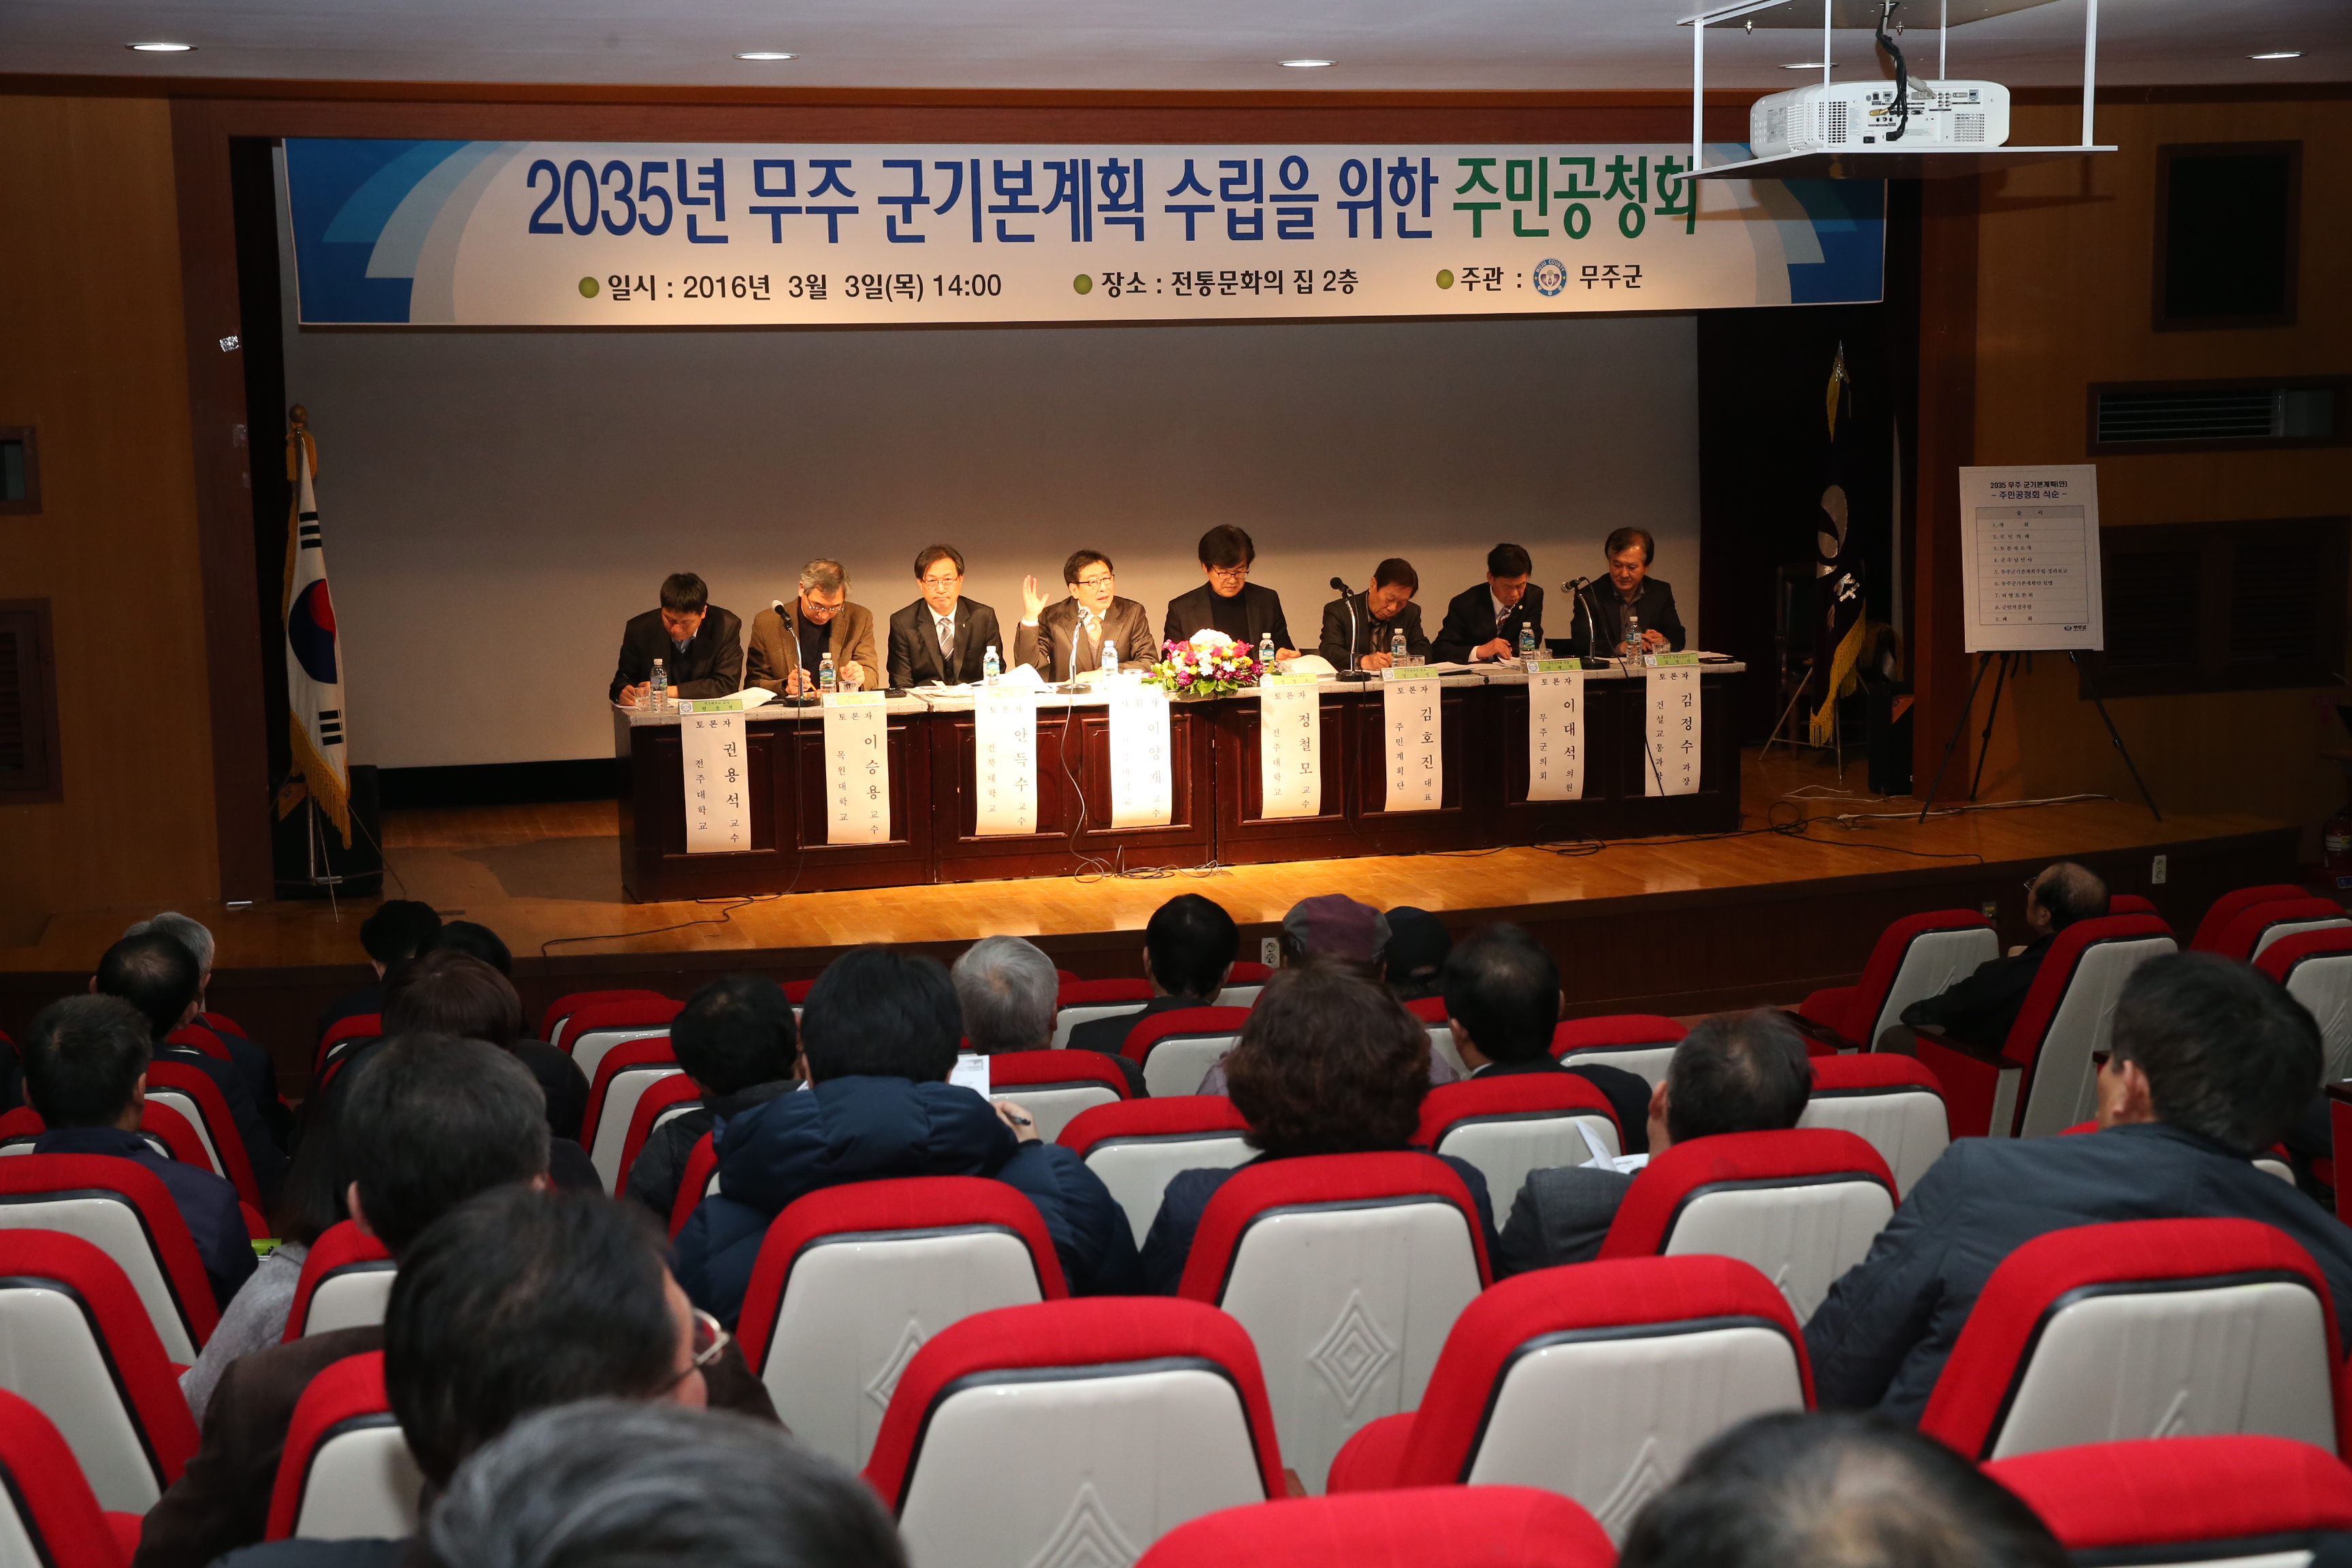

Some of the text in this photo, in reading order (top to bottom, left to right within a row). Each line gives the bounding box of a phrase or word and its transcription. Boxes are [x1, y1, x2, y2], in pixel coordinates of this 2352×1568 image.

[527, 155, 1697, 244] 2035년 무주 군기본계획 수립을 위한 주민공청회
[608, 275, 656, 300] 일시
[684, 275, 770, 300] 2016년
[788, 275, 828, 299] 3월
[845, 274, 924, 301] 3일(목)
[933, 274, 1002, 297] 14:00
[1101, 271, 1147, 297] 장소
[1171, 270, 1284, 296] 전통문화의
[1293, 270, 1313, 295] 집
[1323, 270, 1358, 294] 2층
[1460, 267, 1503, 291] 주관
[1535, 259, 1565, 272] MUJU COUNTY
[1580, 265, 1643, 289] 무주군
[1999, 491, 2040, 499] 주민공청회
[2043, 490, 2059, 498] 식순
[1274, 691, 1306, 700] 토론자
[1396, 685, 1428, 694] 토론자
[1541, 677, 1571, 685] 토론자
[1659, 671, 1689, 680] 토론자
[696, 719, 731, 729] 토론자
[838, 711, 872, 721] 토론자
[989, 705, 1022, 713] 토론자
[1680, 693, 1693, 786] 김정수 과장
[1014, 728, 1028, 826] 안득수 교수
[1147, 721, 1162, 784] 이양재
[1272, 729, 1281, 796] 전주대학교
[1298, 713, 1312, 808] 정철모 교수
[1395, 722, 1405, 790] 주민계획단
[1421, 706, 1433, 801] 김호진 대표
[1539, 713, 1548, 780] 무주군의회
[1564, 698, 1575, 792] 이대석 의원
[695, 759, 708, 830] 전주대학교
[723, 742, 739, 843] 권용석 교수
[836, 751, 848, 821] 목원대학교
[864, 734, 881, 834] 이승용 교수
[987, 743, 996, 813] 전북대학교
